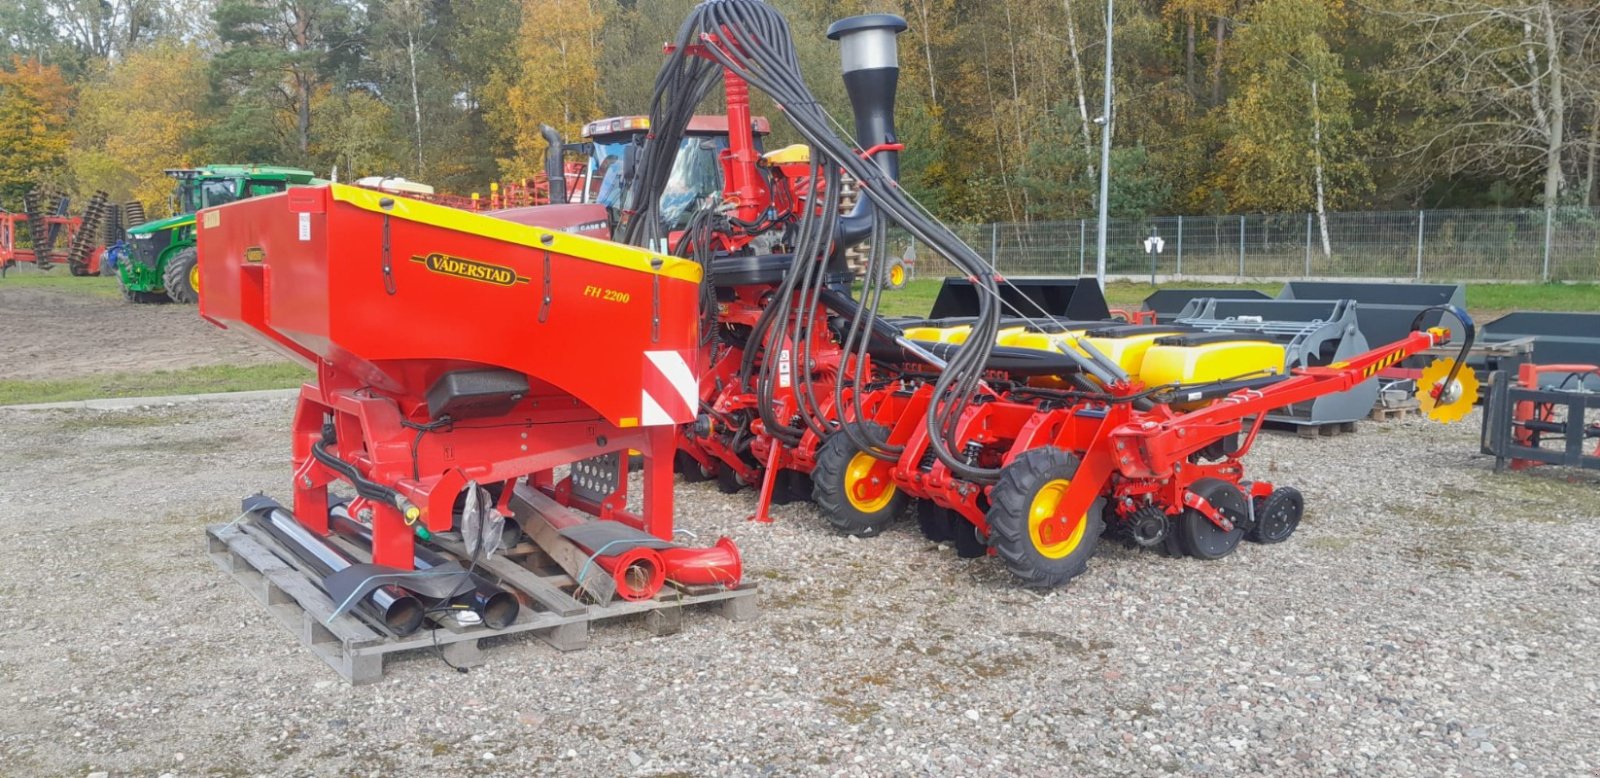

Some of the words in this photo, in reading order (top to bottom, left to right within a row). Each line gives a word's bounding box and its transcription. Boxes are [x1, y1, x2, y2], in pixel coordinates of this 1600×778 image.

[580, 223, 599, 231] CASE
[432, 256, 511, 283] VÄDERSTAD
[584, 285, 601, 298] FH
[604, 289, 630, 304] 2200
